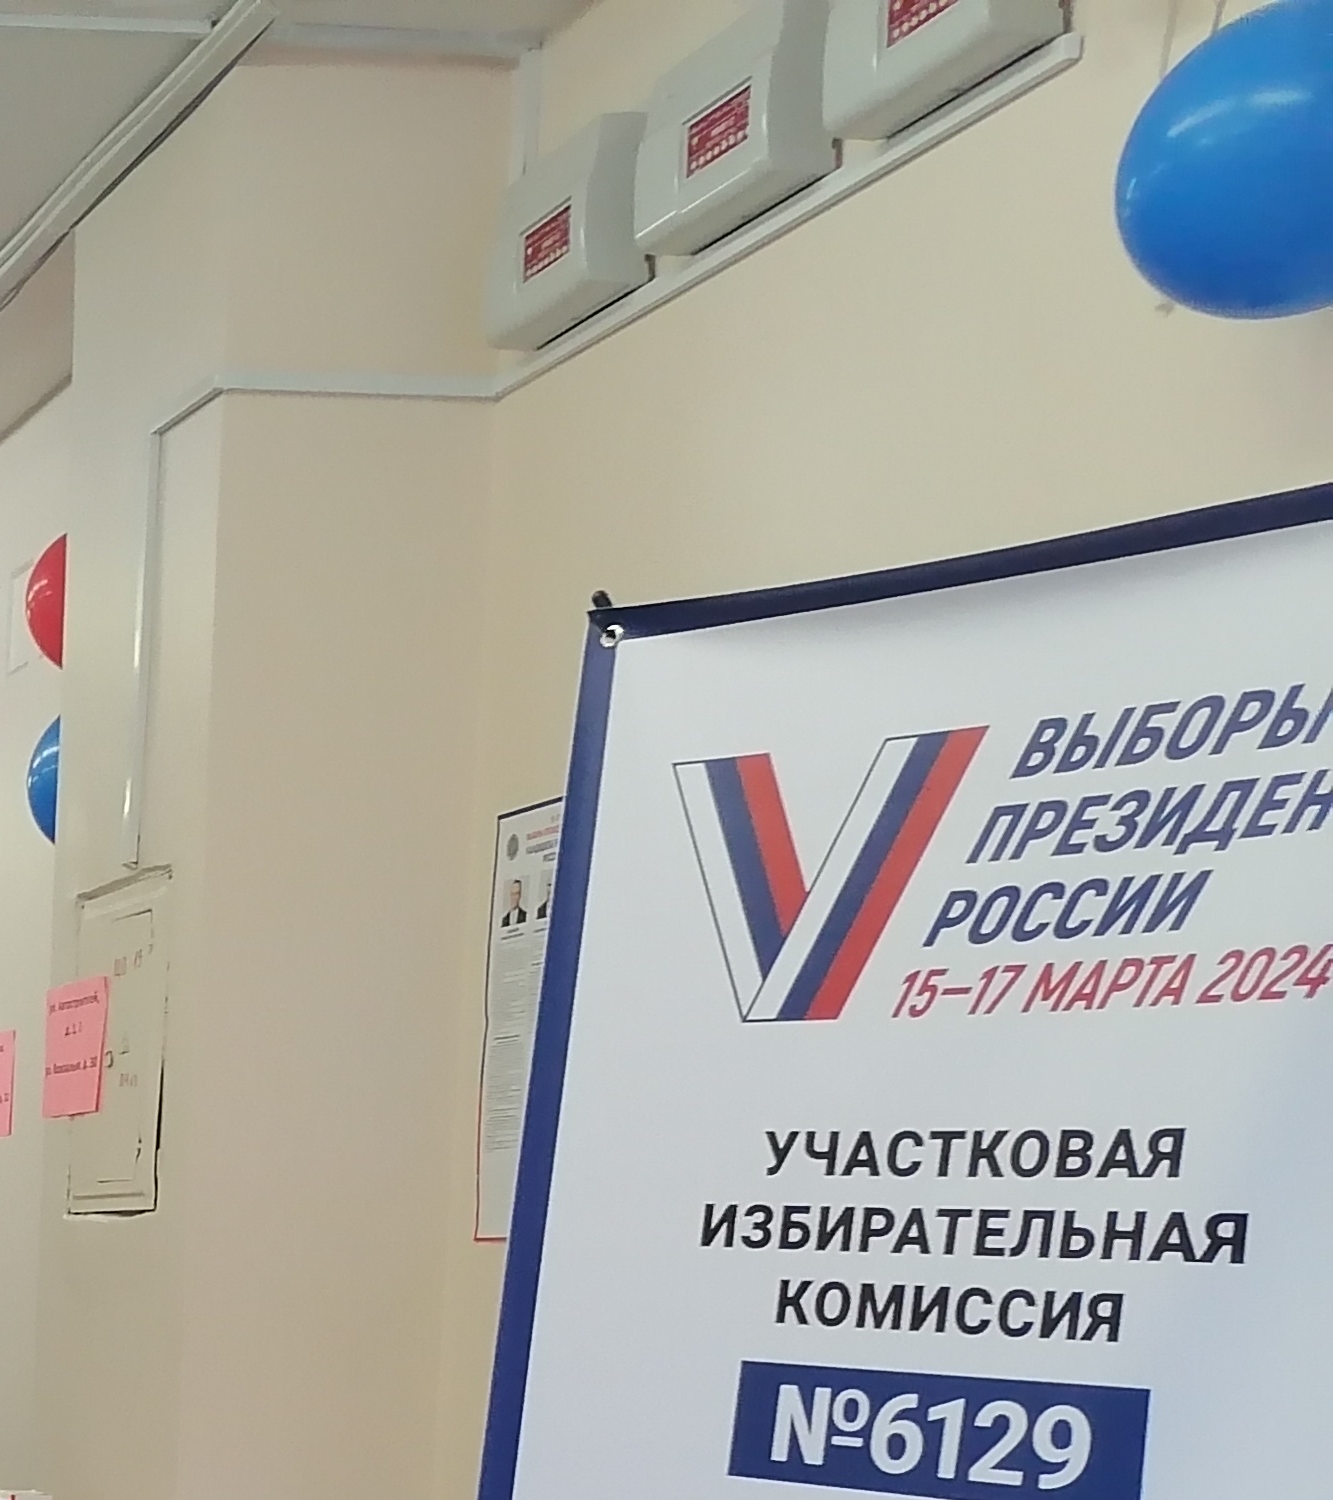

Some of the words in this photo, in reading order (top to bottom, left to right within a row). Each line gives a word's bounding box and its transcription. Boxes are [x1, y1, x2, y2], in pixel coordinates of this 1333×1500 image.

[1010, 684, 1333, 779] ВЫБОРЫ
[922, 870, 1214, 947] РОССИИ
[1020, 954, 1197, 1013] МАРТА
[1195, 944, 1333, 1004] 2024
[765, 1128, 1187, 1178] УЧАСТКОВАЯ
[700, 1204, 1249, 1264] ИЗБИРАТЕЛЬНАЯ
[775, 1280, 1124, 1342] КОМИССИЯ
[772, 1384, 1093, 1489] №6129
